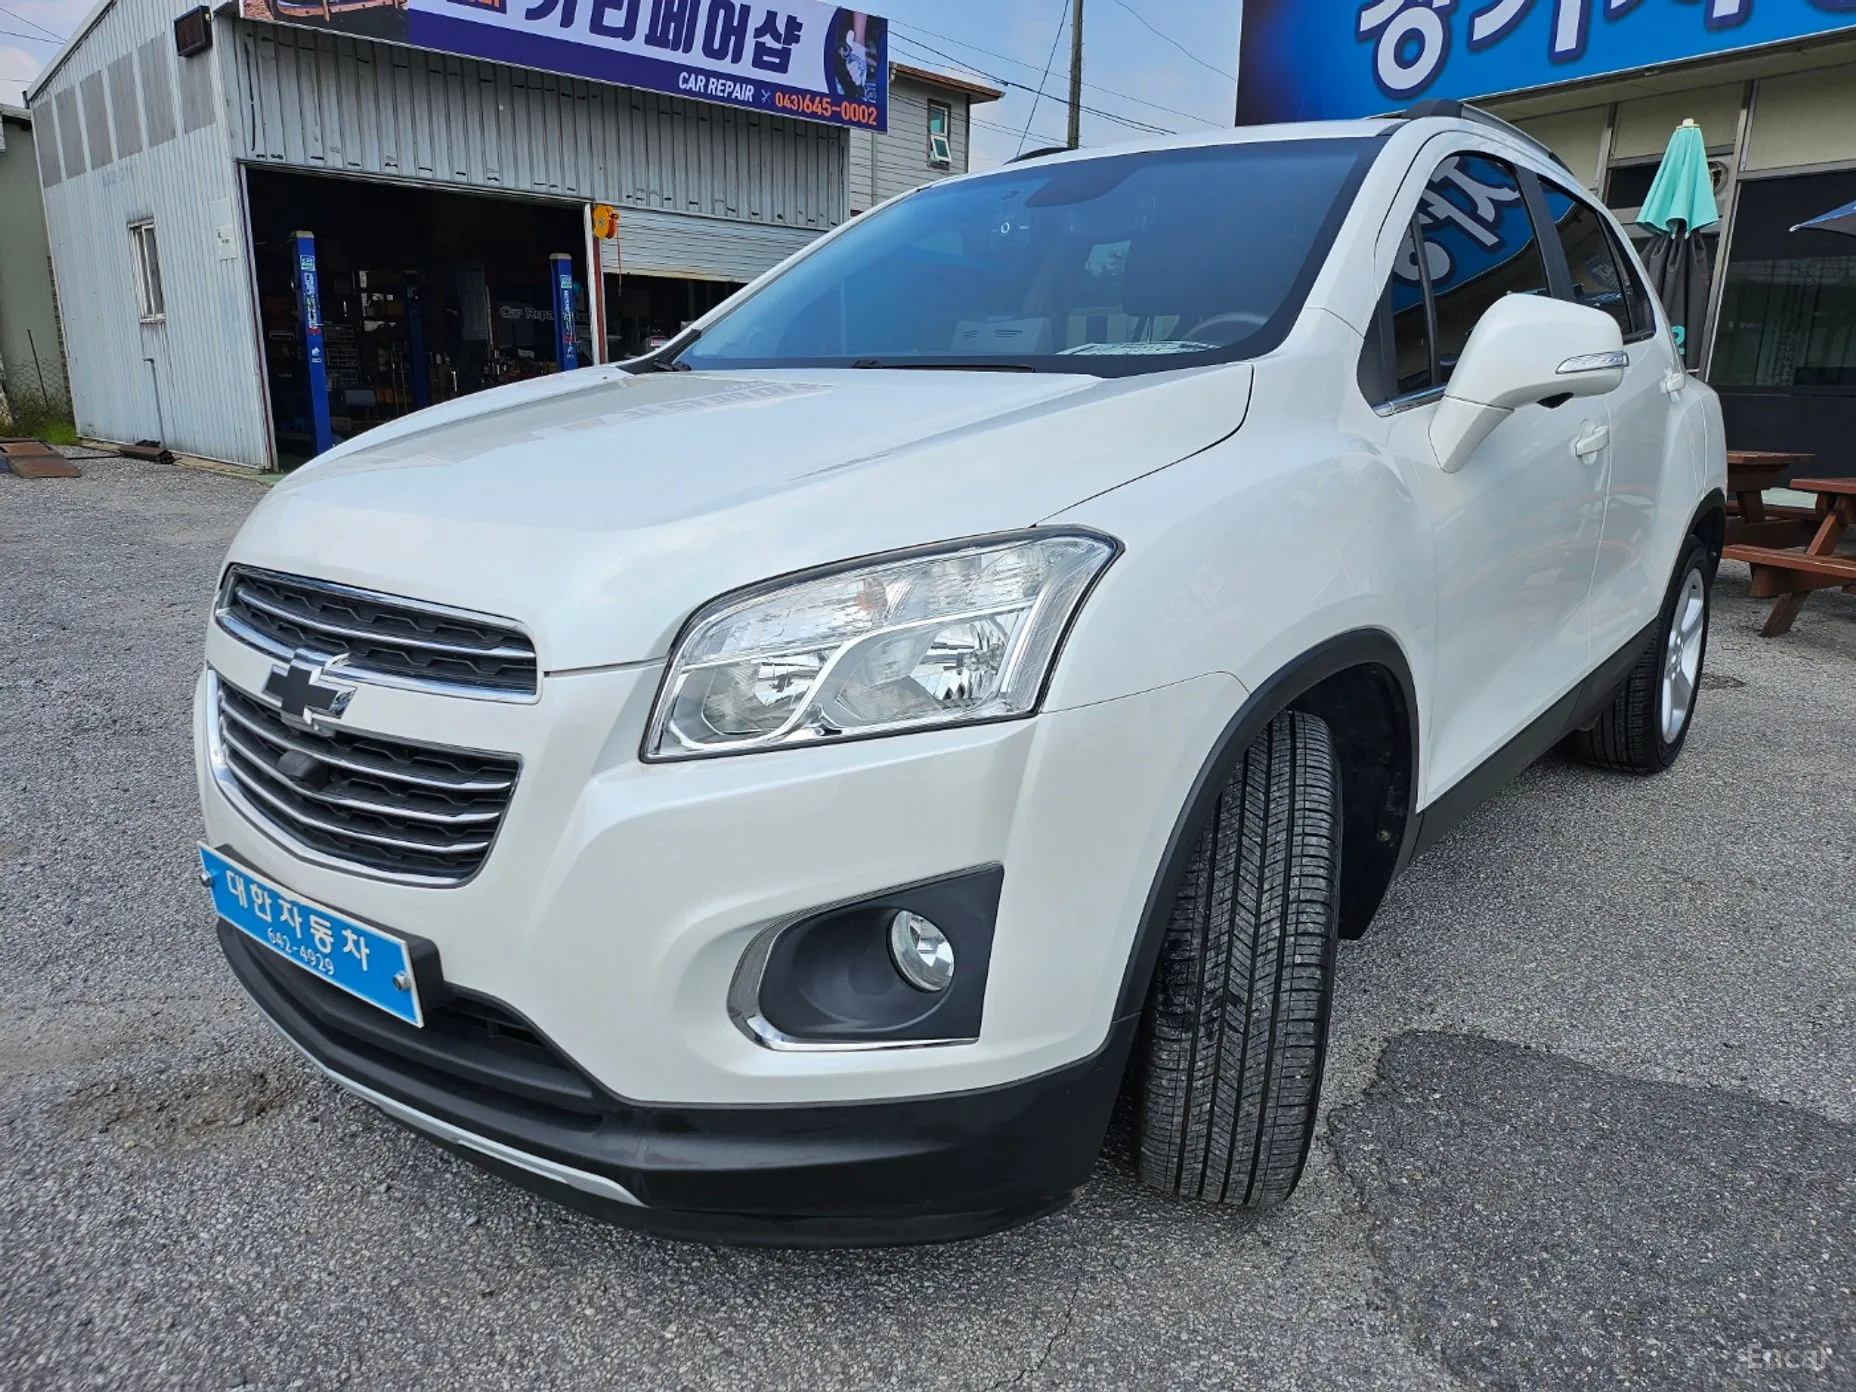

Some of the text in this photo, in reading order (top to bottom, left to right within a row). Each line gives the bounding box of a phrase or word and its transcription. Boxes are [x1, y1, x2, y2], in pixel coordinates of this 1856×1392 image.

[679, 72, 878, 126] CAR REPAIR 043)645-0002
[227, 869, 370, 971] 대한자동차
[267, 927, 335, 976] 642-4929
